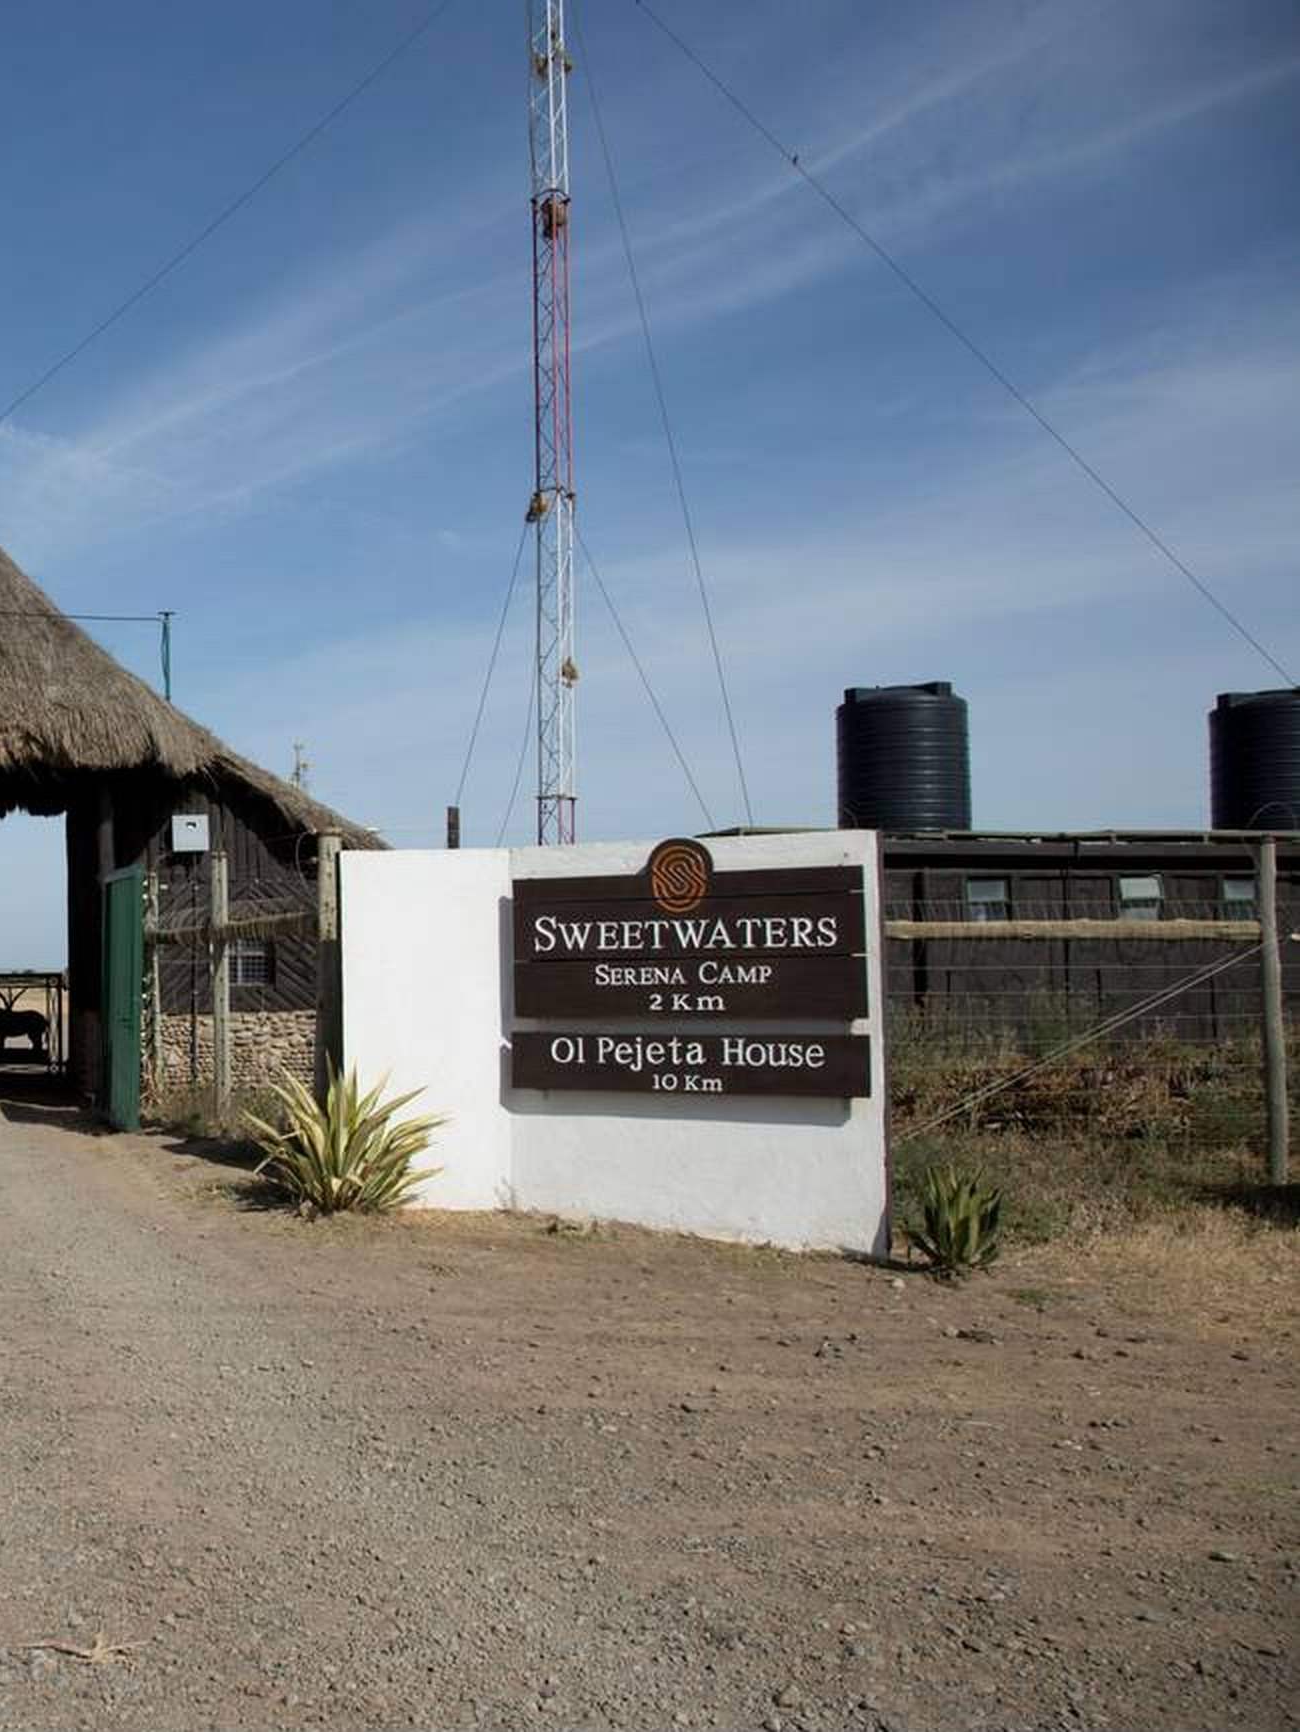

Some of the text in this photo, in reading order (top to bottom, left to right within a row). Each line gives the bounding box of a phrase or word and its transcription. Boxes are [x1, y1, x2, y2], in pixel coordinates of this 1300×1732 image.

[534, 915, 838, 952] SWEETWATERS
[594, 961, 773, 986] SERENA CAMP
[648, 994, 663, 1011] 2
[550, 1036, 826, 1071] Ol Pejeta House
[652, 1073, 679, 1092] 10
